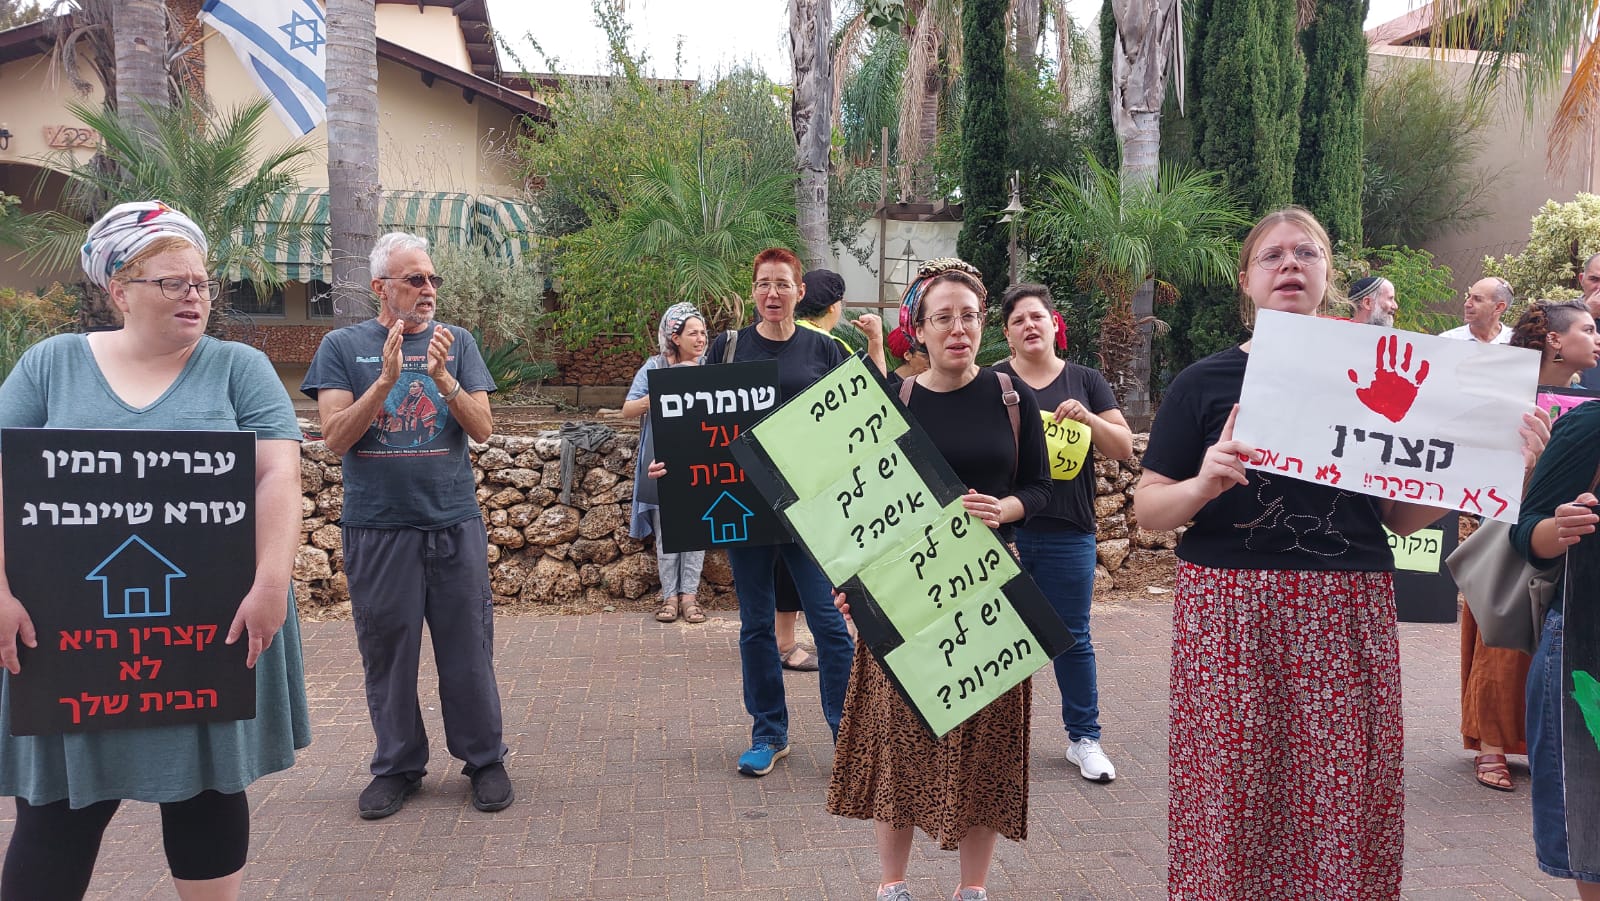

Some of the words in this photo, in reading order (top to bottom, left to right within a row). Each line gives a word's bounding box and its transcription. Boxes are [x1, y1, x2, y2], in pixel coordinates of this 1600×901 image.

[660, 386, 776, 418] שומרים
[810, 374, 867, 423] תושב
[701, 421, 740, 448] על
[1043, 421, 1080, 444] שומ
[42, 449, 122, 478] המין
[1054, 450, 1077, 472] על
[1331, 425, 1455, 473] קצרין
[133, 451, 236, 479] עבריין
[878, 452, 898, 479] יש
[1315, 463, 1341, 485] לא
[836, 465, 867, 519] לך
[1459, 487, 1508, 517] לא
[22, 501, 153, 526] שיינברג
[164, 501, 247, 525] עזרא
[850, 490, 924, 549] אישה?
[950, 511, 971, 539] יש
[909, 524, 939, 580] לך
[927, 548, 1001, 609] בנות?
[980, 598, 1001, 627] יש
[59, 628, 118, 651] היא
[129, 624, 219, 654] קצרין
[938, 611, 969, 667] לך
[119, 656, 163, 681] לא
[936, 638, 1032, 710] חברות?
[59, 692, 129, 724] שלך
[139, 689, 218, 712] הבית
